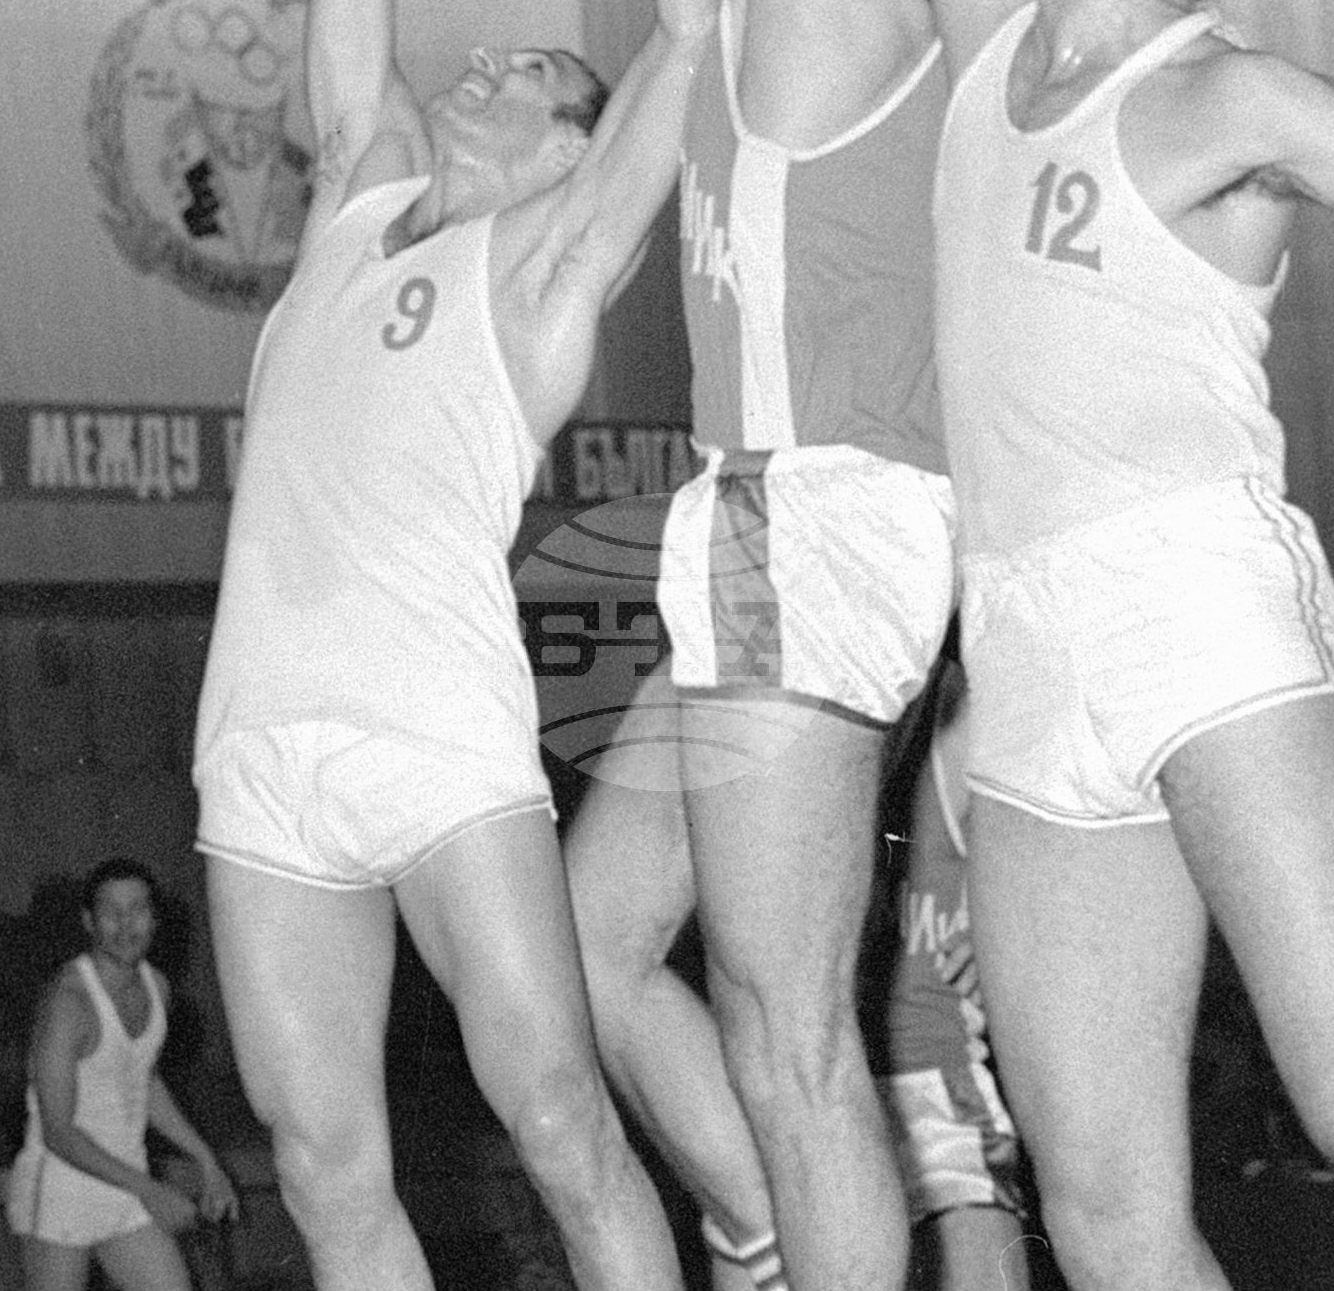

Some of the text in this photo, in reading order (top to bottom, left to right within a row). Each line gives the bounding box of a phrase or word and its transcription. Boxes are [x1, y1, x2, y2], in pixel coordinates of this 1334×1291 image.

[1023, 160, 1104, 273] 12
[380, 276, 438, 352] 9
[29, 411, 201, 498] МЕЖДУ
